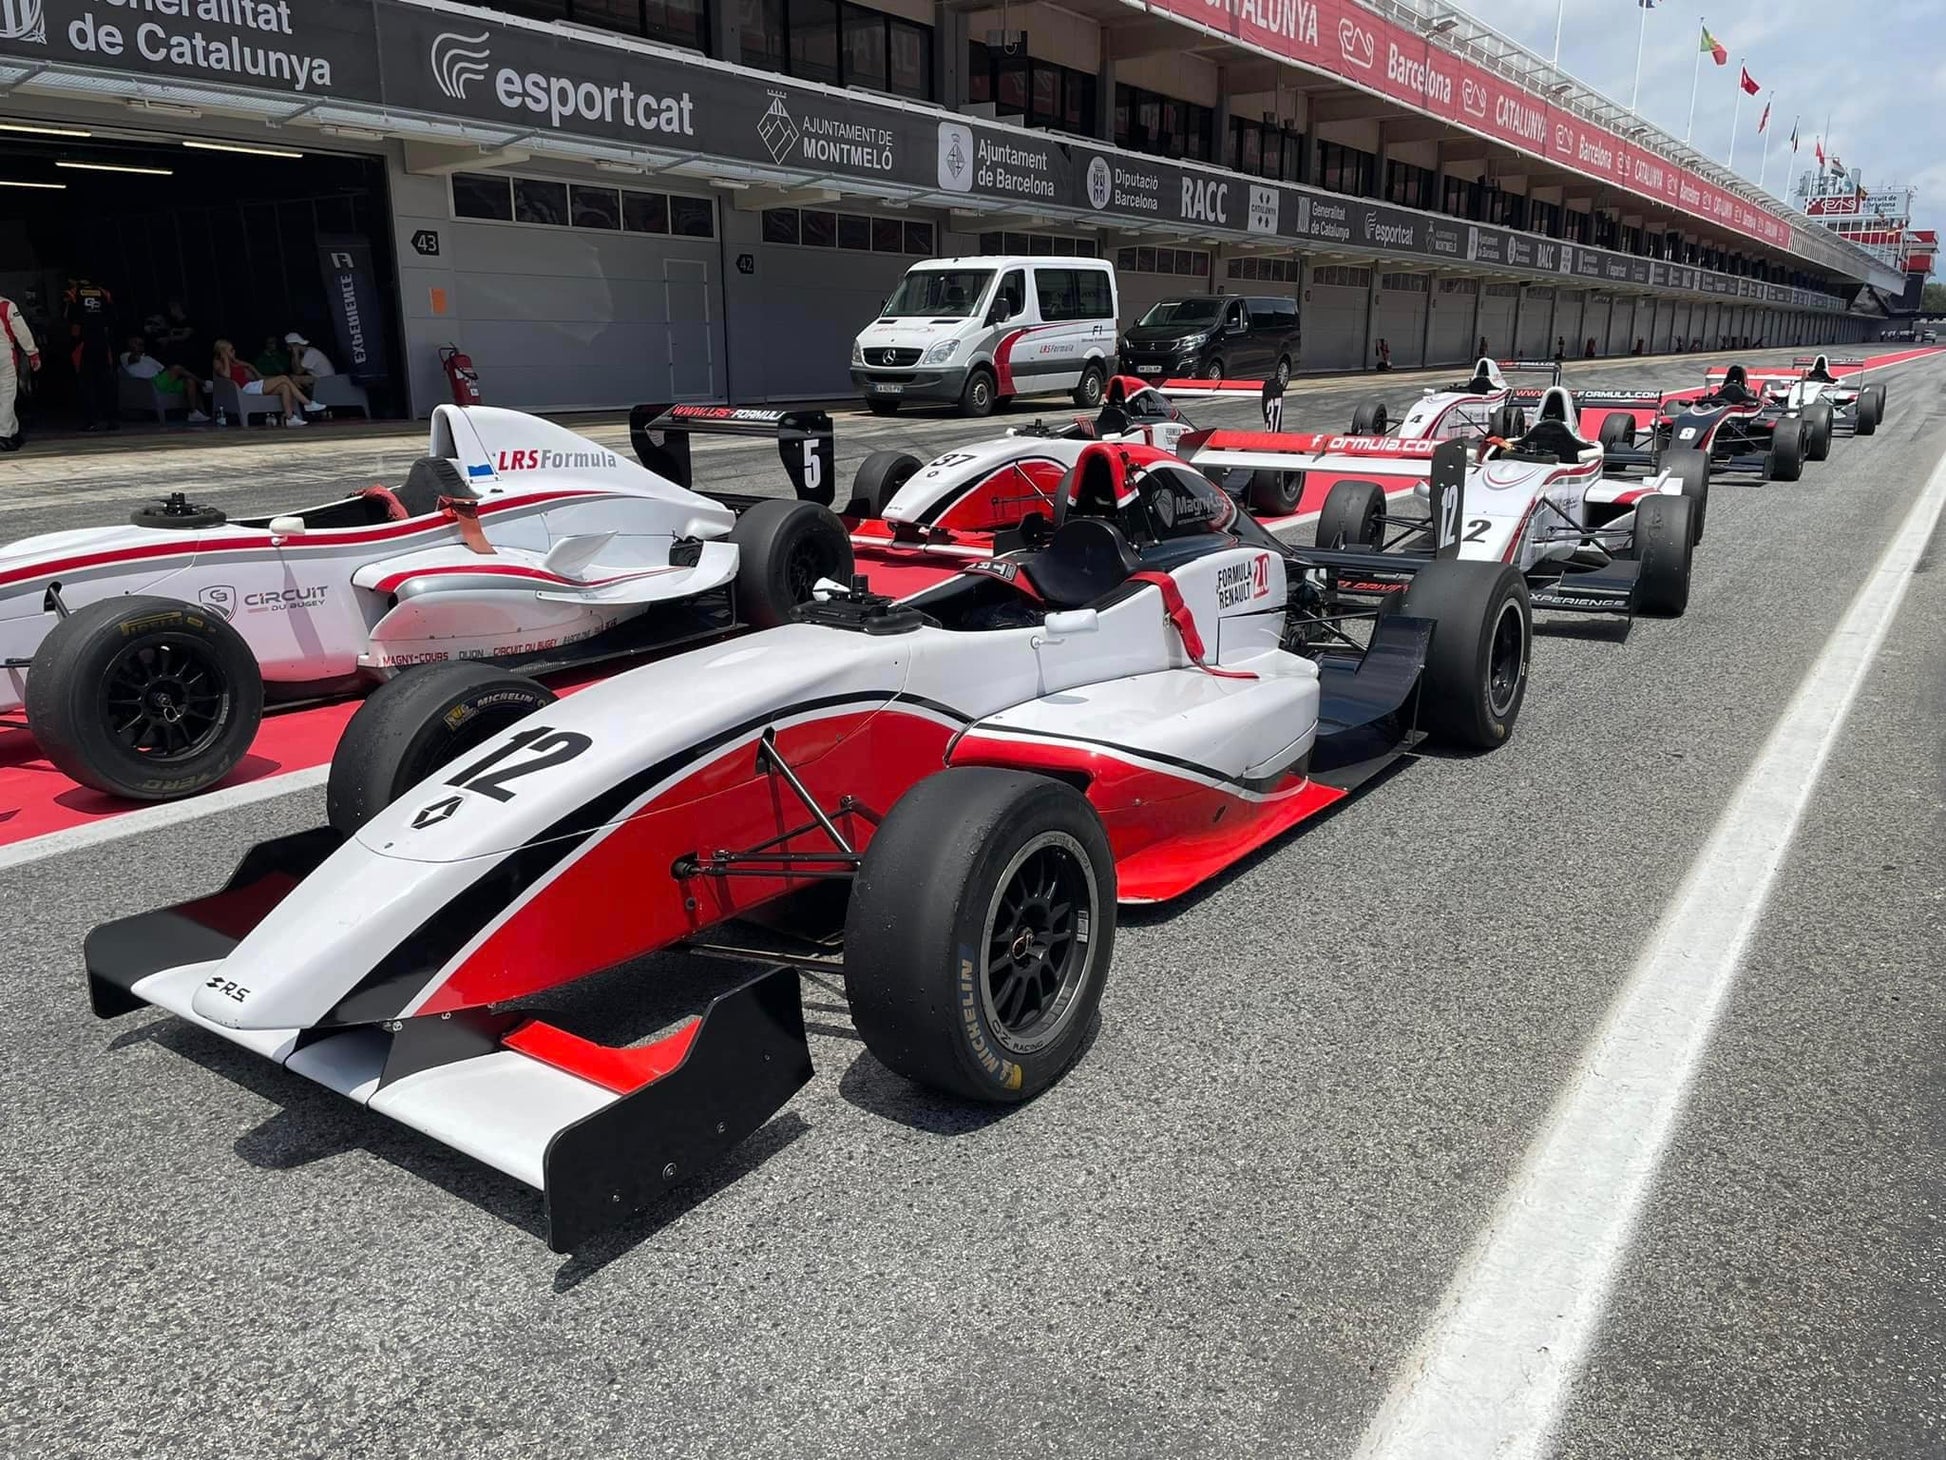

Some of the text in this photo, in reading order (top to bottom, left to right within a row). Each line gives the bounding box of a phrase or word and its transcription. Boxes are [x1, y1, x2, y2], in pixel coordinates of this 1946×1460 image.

[68, 12, 333, 91] de Catalunya
[1387, 43, 1452, 104] Barcelona
[495, 66, 695, 137] esportcat
[802, 115, 894, 147] AJUNTAMENT DE
[1496, 95, 1547, 143] CATALUNYA
[803, 137, 894, 171] MONTMELÓ
[978, 139, 1048, 171] Ajuntament
[977, 167, 1055, 198] de Barcelona
[1115, 168, 1159, 191] Diputació
[1115, 190, 1158, 211] Barcelona
[1181, 176, 1228, 224] RACC
[417, 233, 438, 252] 43
[1374, 222, 1414, 248] esportcat
[739, 257, 753, 273] 42
[1266, 397, 1282, 433] 37
[498, 449, 617, 471] LRSFormula
[803, 438, 821, 489] 5
[930, 453, 977, 467] 37
[1440, 484, 1459, 549] 12
[1462, 519, 1492, 543] 2
[1217, 560, 1253, 590] FORMULA
[290, 600, 327, 609] BUGEY
[1219, 581, 1251, 610] RENAULT
[1529, 592, 1626, 606] XPERIENCE
[383, 652, 449, 666] MAGNY-COURS
[493, 644, 524, 657] CIRCUIT
[477, 692, 534, 707] MICHELIN
[443, 726, 594, 803] 12
[960, 959, 1000, 1073] MICHELIN
[1013, 1042, 1044, 1051] RACING
